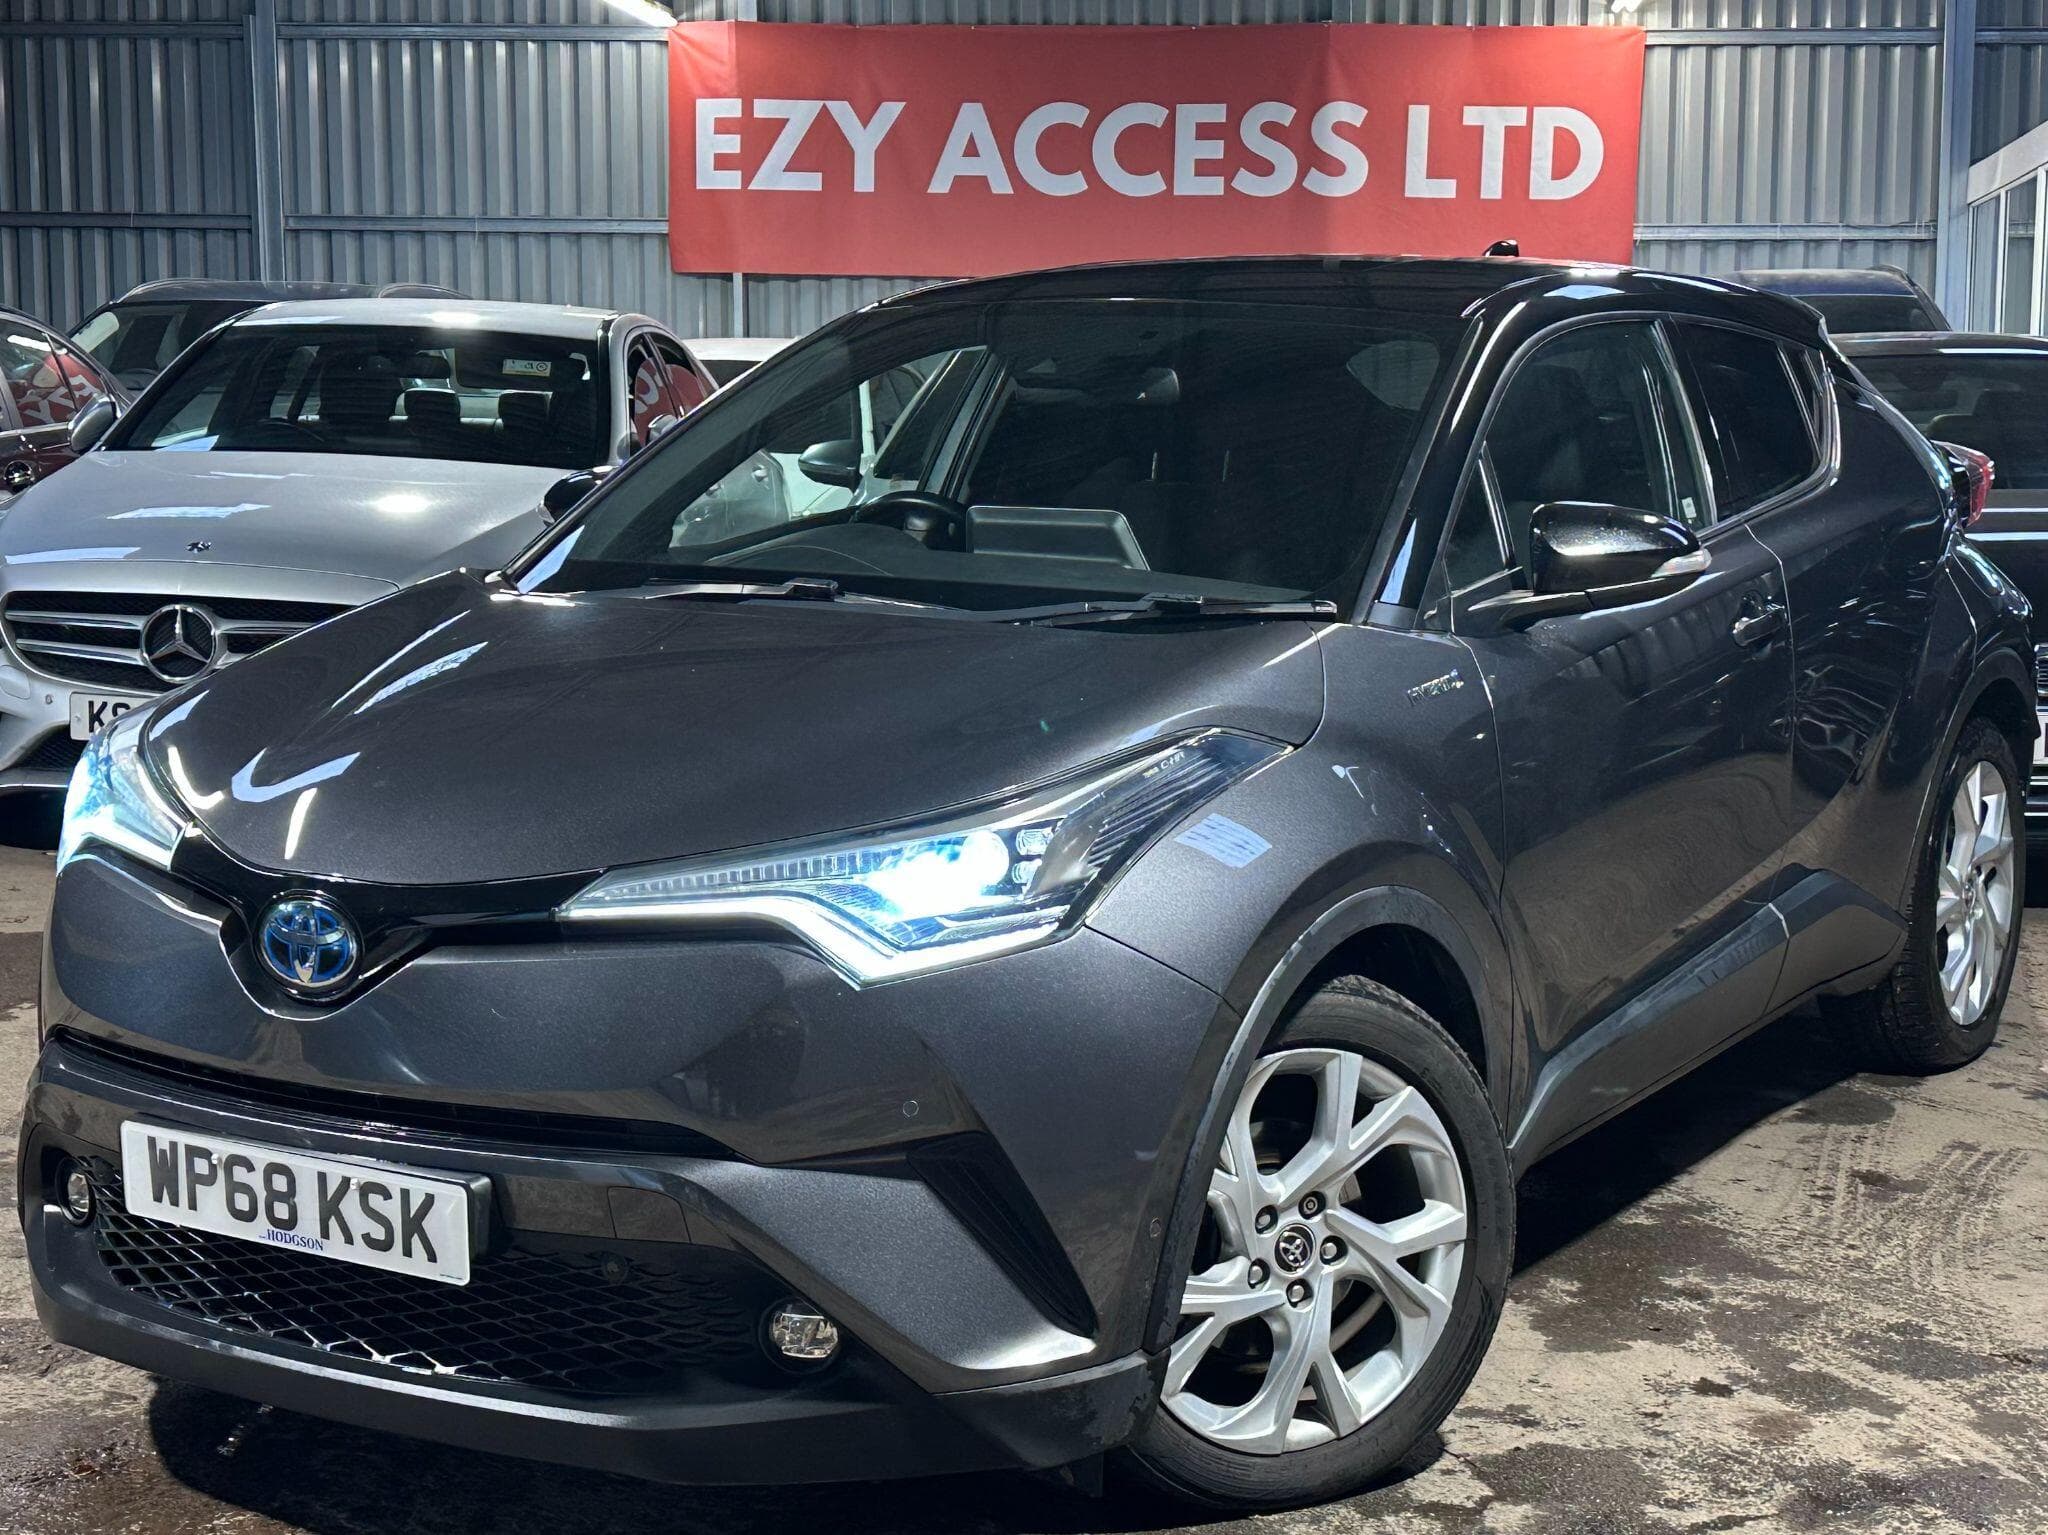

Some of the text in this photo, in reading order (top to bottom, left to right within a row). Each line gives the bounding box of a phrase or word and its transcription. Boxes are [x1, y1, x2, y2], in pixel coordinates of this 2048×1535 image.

[695, 98, 1604, 201] EZY ACCESS LTD
[147, 1135, 438, 1264] WP68 KSK
[266, 1228, 324, 1252] HODGSON
